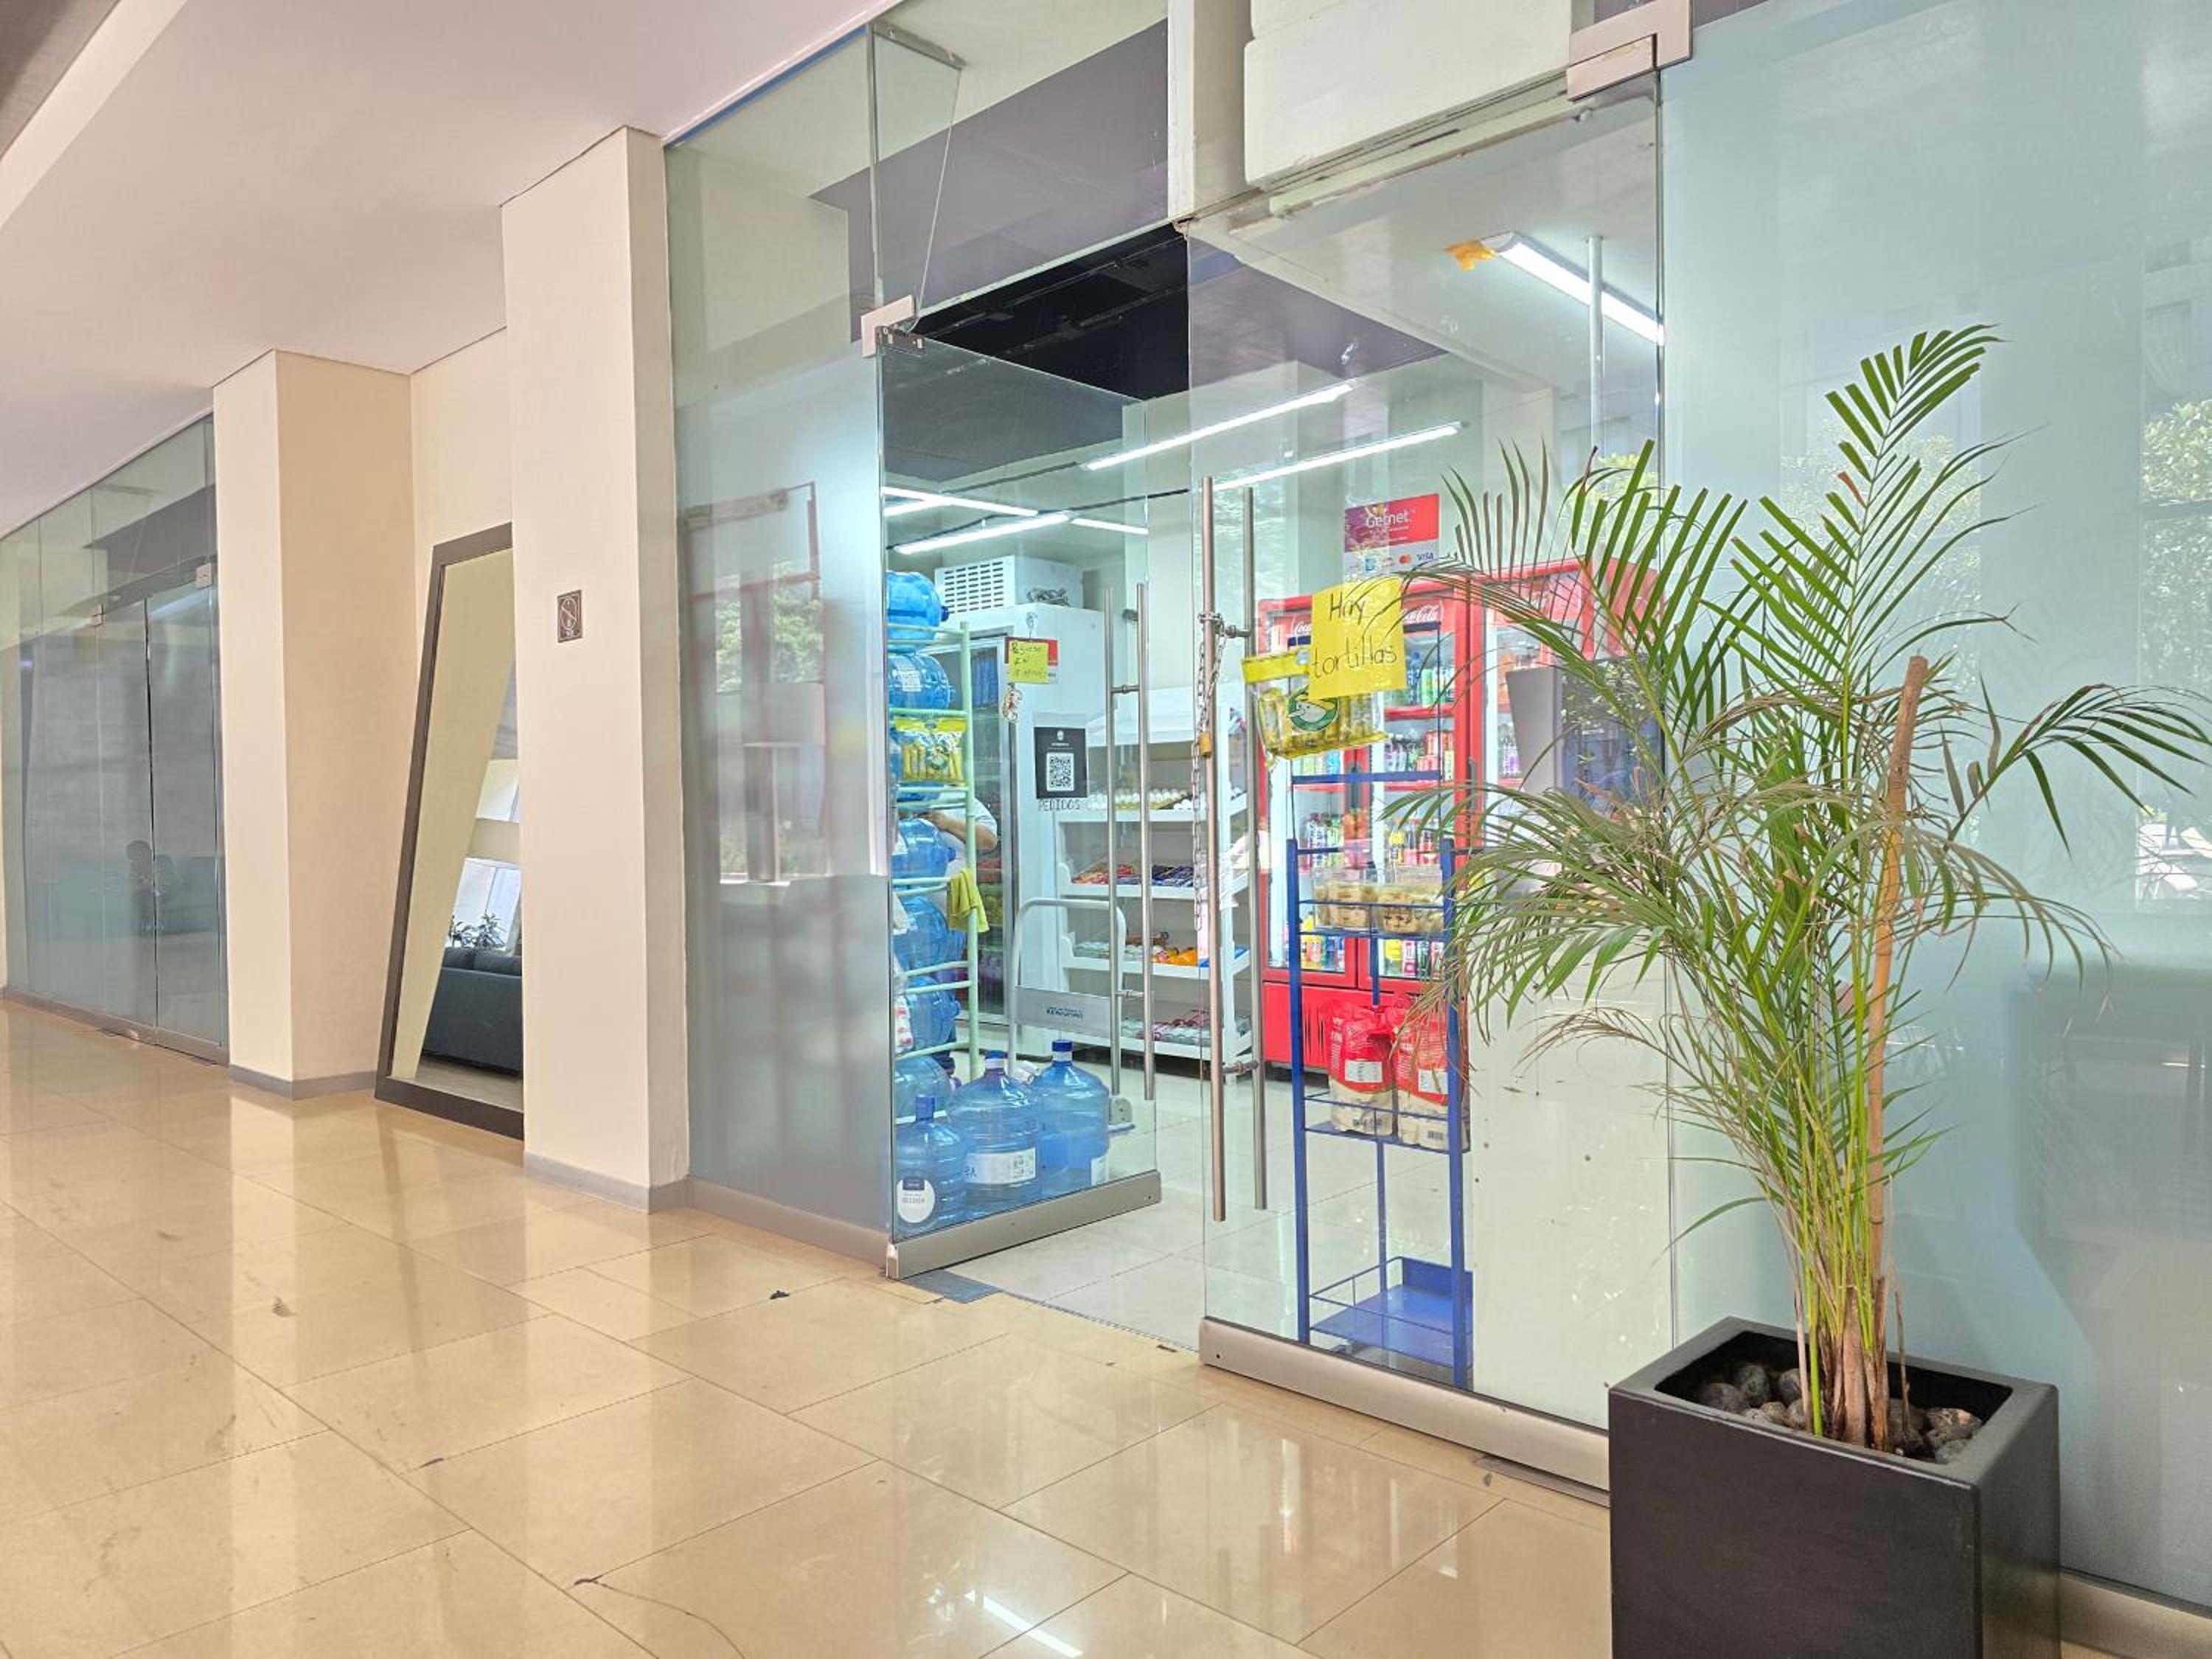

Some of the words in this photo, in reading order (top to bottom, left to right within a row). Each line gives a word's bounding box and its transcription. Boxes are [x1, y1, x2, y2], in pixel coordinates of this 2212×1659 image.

[1329, 591, 1366, 625] Hay
[1310, 635, 1397, 678] tortillas
[1038, 799, 1080, 812] PEDIDOS
